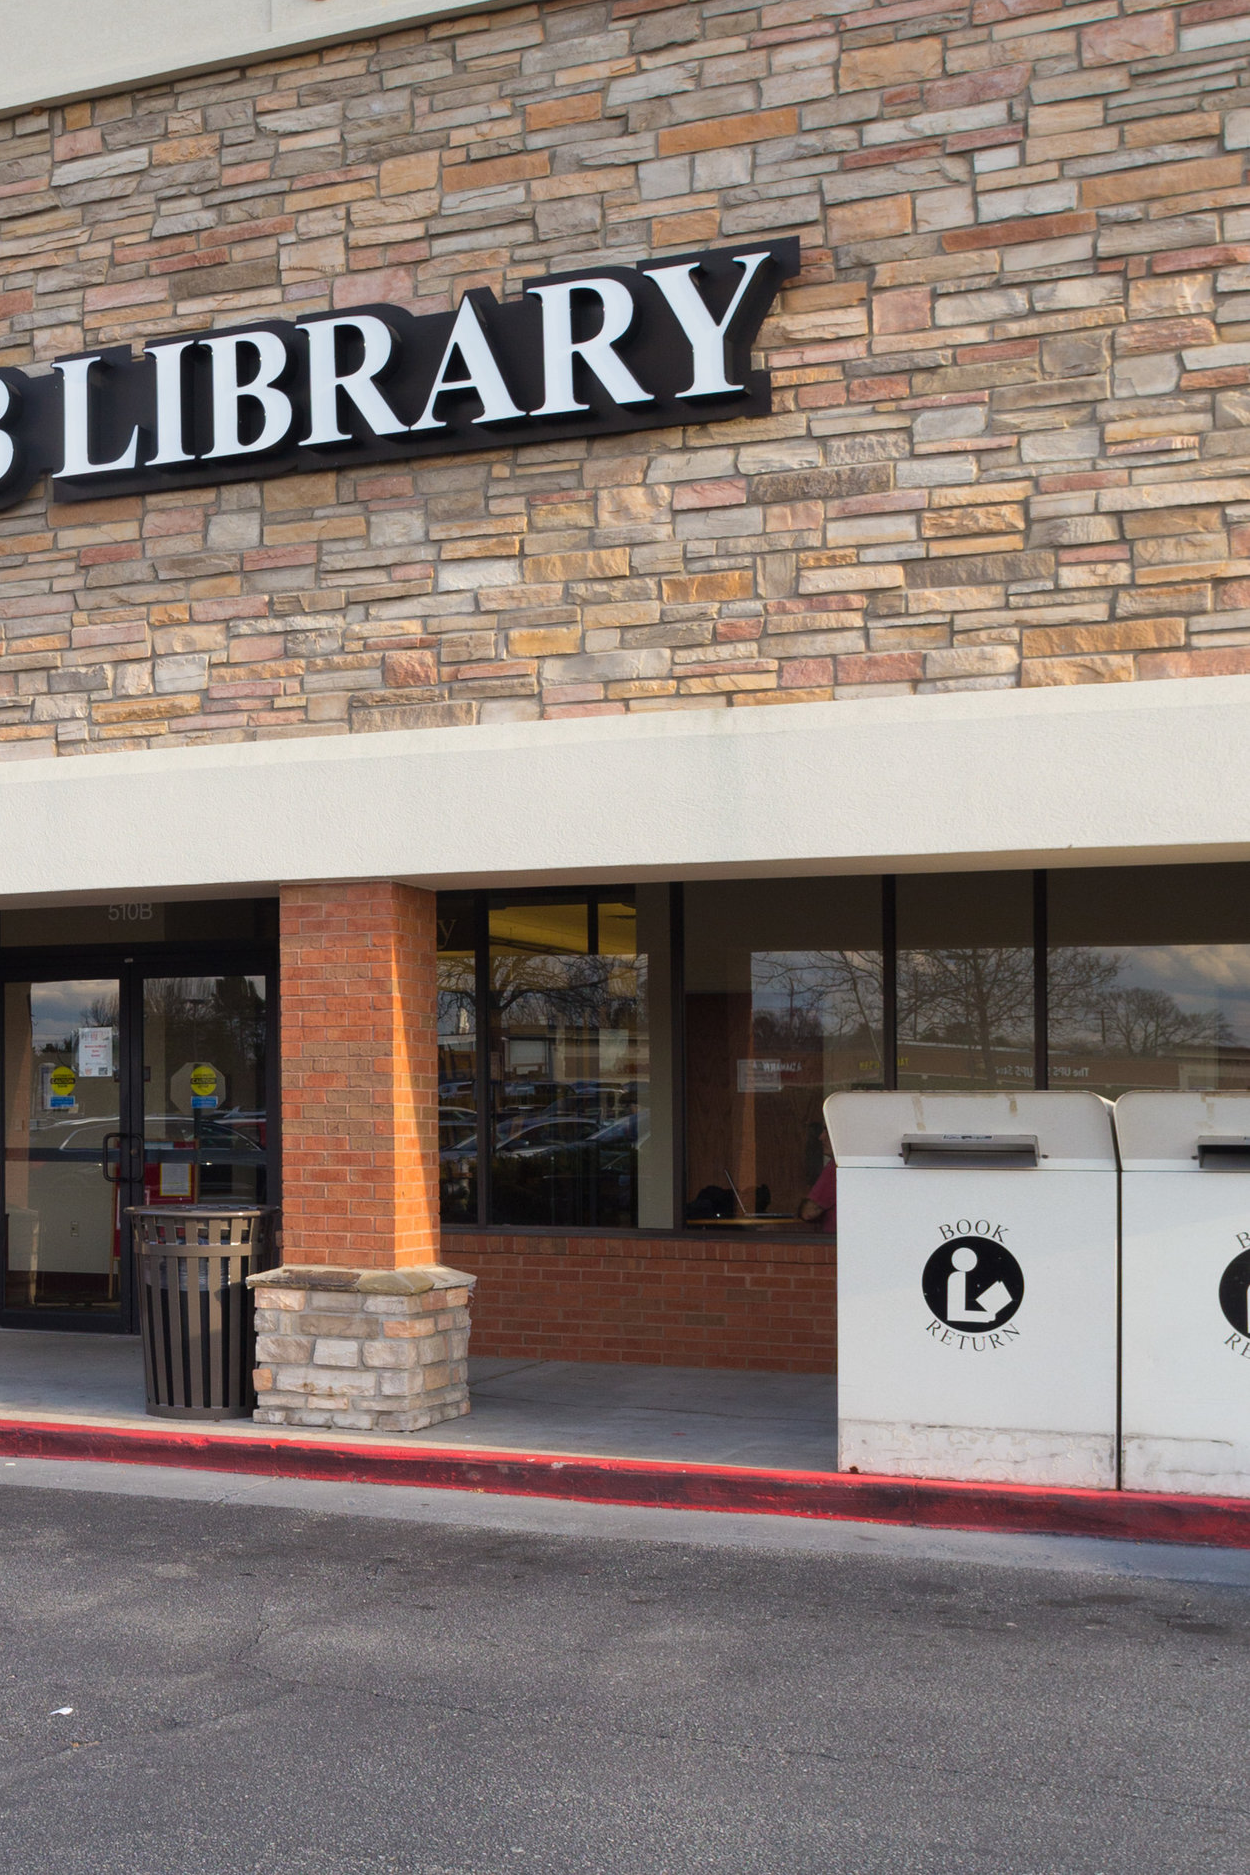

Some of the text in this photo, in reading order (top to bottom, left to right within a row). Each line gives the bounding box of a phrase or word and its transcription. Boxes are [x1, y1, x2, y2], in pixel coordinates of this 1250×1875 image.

[51, 251, 771, 479] LIBRARY
[938, 1218, 1010, 1245] BOOK
[925, 1319, 1021, 1352] RETURN
